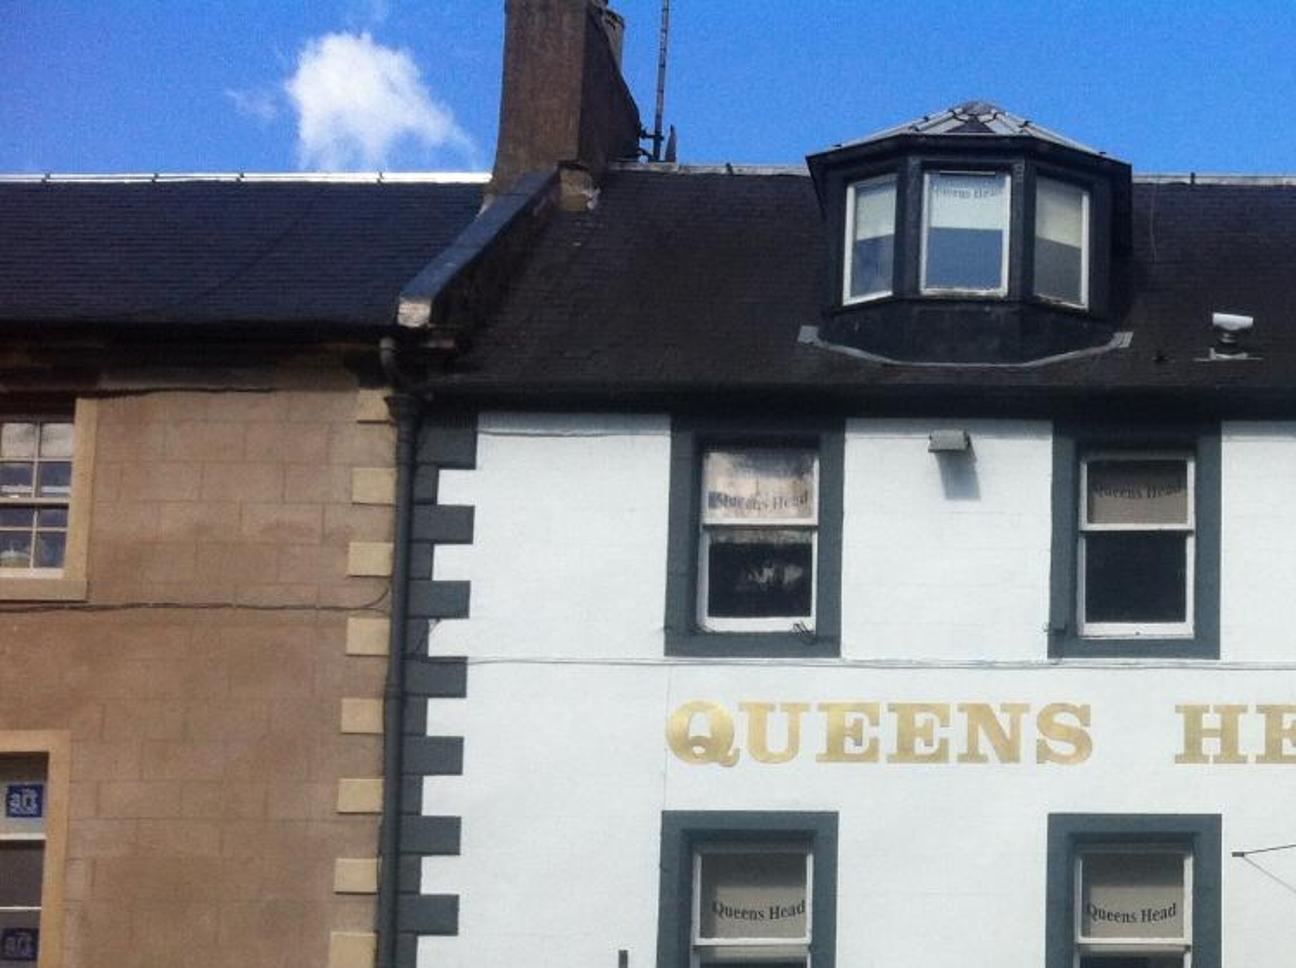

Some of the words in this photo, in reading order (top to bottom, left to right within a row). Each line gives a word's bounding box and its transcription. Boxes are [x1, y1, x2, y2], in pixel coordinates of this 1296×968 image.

[772, 488, 809, 510] Head
[665, 702, 1093, 767] QUEENS
[712, 901, 765, 920] Queens
[769, 899, 806, 920] Head
[1087, 902, 1138, 923] Queens
[1141, 902, 1177, 923] Head
